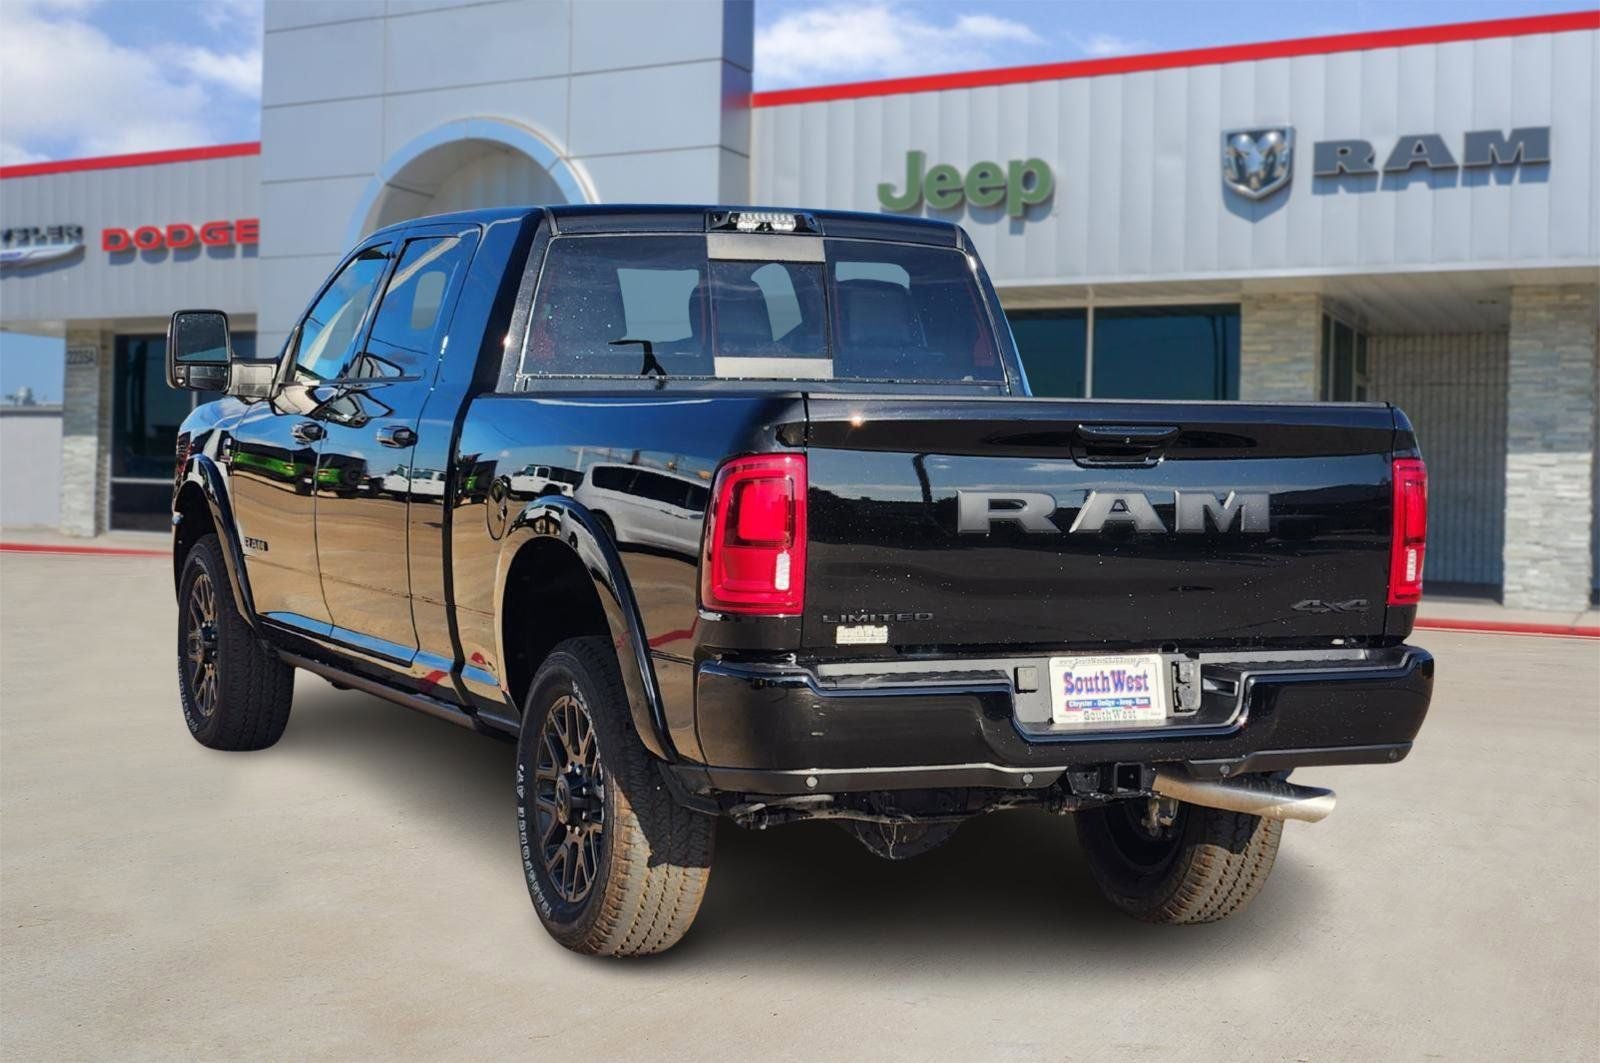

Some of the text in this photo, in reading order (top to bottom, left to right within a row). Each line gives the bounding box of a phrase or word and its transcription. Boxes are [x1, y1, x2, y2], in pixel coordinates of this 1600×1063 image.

[1313, 126, 1551, 175] RAM
[877, 150, 1053, 217] Jeep
[102, 218, 260, 251] DODGE
[957, 489, 1271, 534] RAM
[822, 613, 934, 623] LIMITED
[1063, 669, 1149, 695] SouthWest
